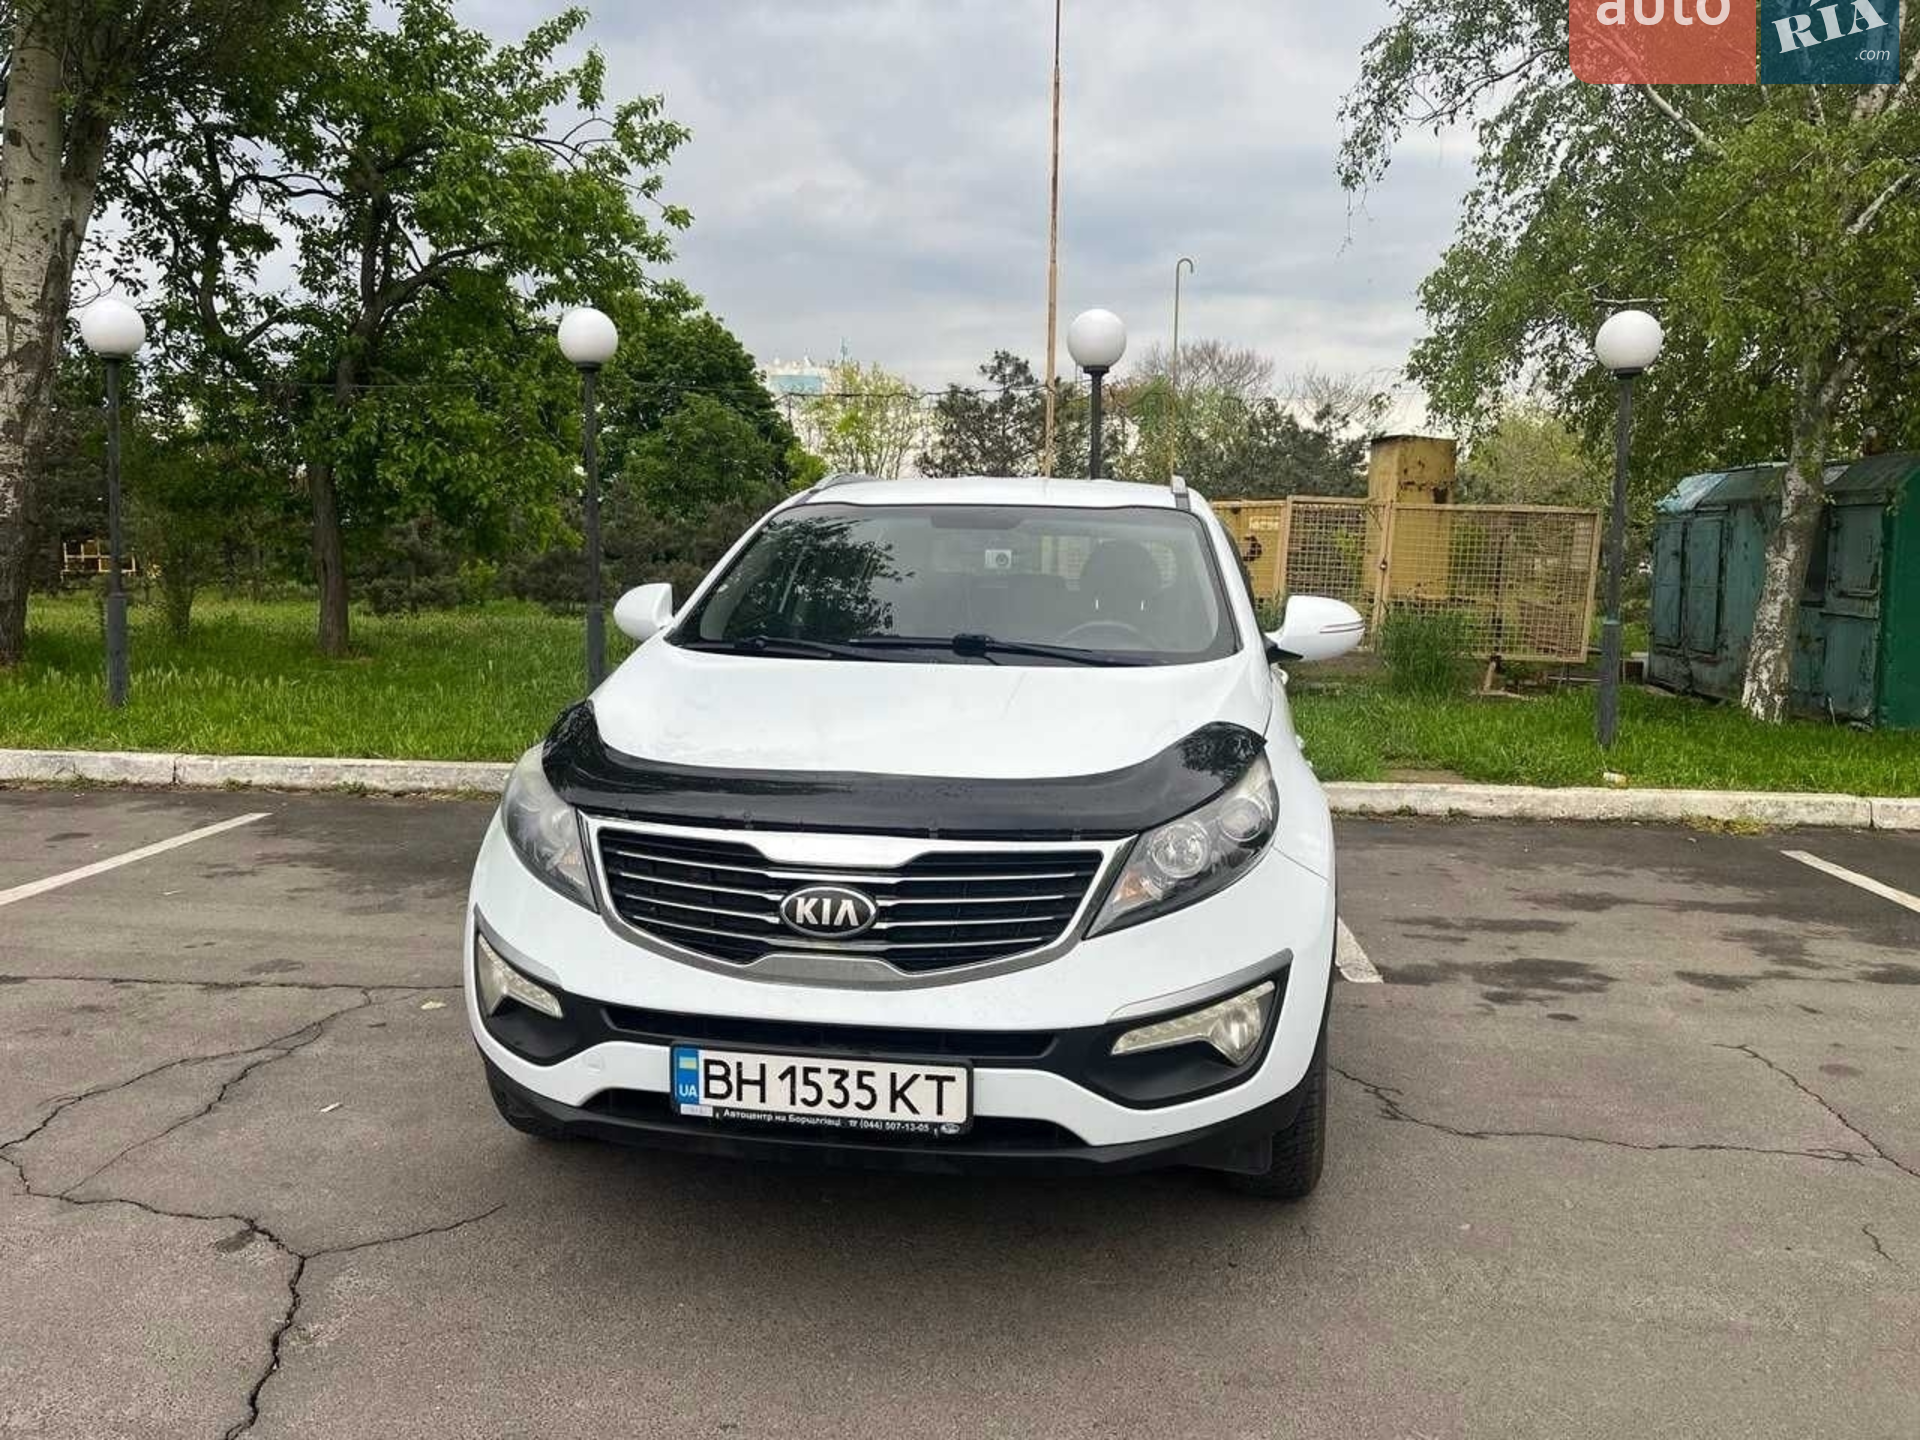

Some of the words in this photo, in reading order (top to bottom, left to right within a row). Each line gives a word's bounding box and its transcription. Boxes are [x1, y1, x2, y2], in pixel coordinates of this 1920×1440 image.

[795, 896, 860, 926] KIA
[678, 1083, 698, 1098] UA
[703, 1058, 767, 1104] BH
[778, 1065, 878, 1111] 1535
[889, 1071, 957, 1116] KT
